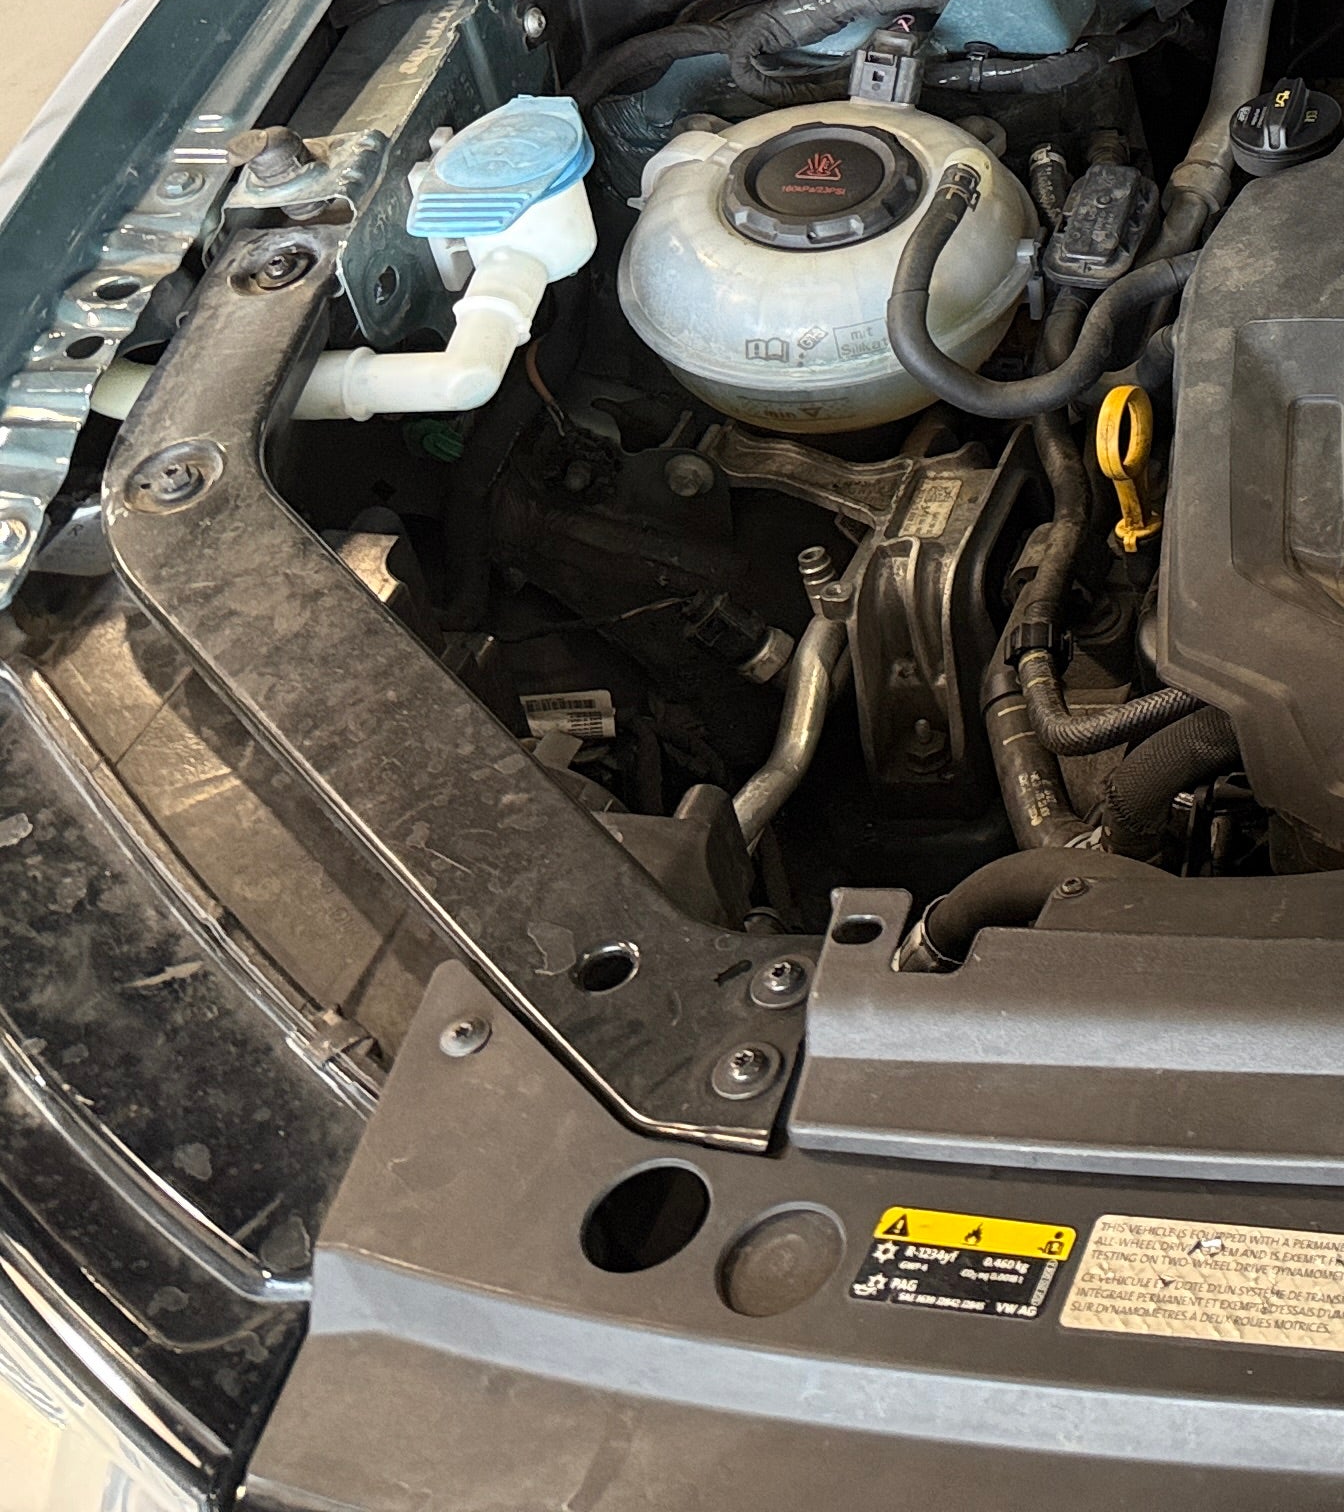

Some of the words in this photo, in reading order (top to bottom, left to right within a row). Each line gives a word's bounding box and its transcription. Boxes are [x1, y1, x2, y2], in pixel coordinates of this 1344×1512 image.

[850, 326, 874, 340] mit
[1101, 1221, 1126, 1232] THIS
[1128, 1224, 1176, 1237] VEHICLE
[1176, 1229, 1187, 1238] IS
[1249, 1235, 1280, 1246] WITH
[1281, 1238, 1290, 1247] A
[905, 1245, 959, 1264] R-1234yf
[1014, 1260, 1030, 1274] kg
[1092, 1249, 1138, 1262] TESTING
[1139, 1254, 1158, 1264] ON
[1162, 1255, 1231, 1271] TWO-WHEEL
[1240, 1248, 1267, 1259] AND
[890, 1277, 918, 1291] PAG
[1136, 1292, 1203, 1306] PERMANENT
[1204, 1298, 1218, 1308] ET
[1287, 1290, 1302, 1300] DE
[996, 1302, 1018, 1313] VW
[1017, 1305, 1037, 1316] AG
[1070, 1301, 1093, 1312] SUR
